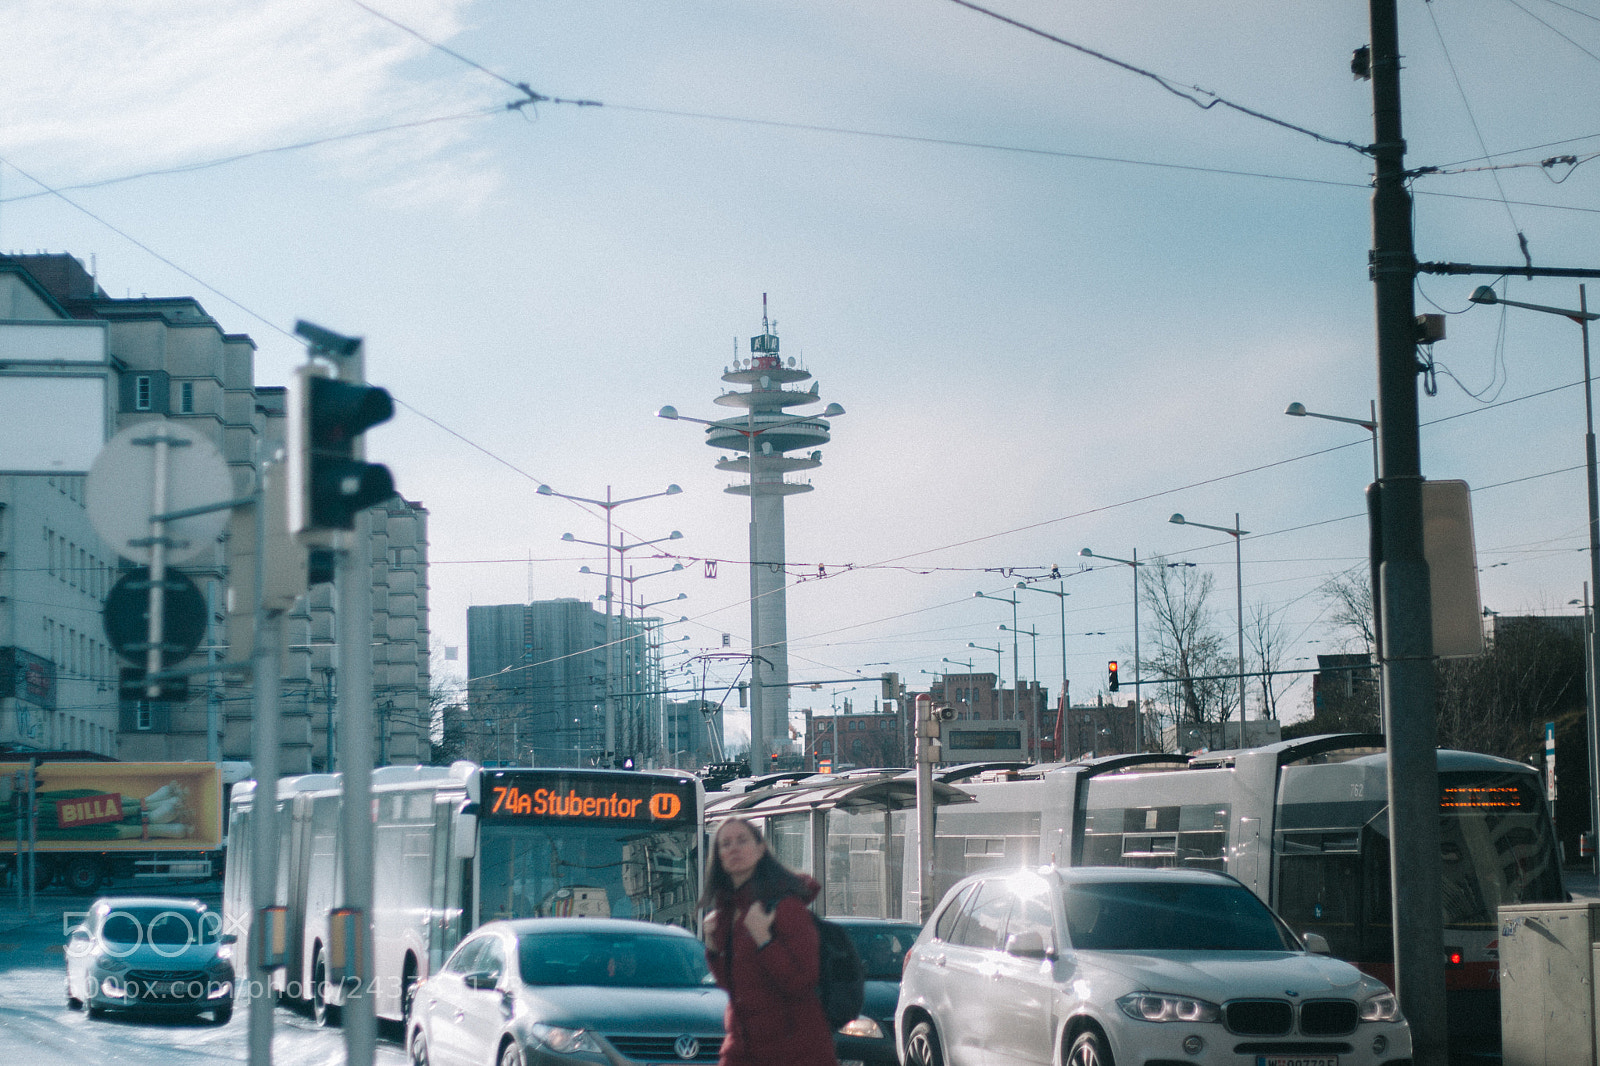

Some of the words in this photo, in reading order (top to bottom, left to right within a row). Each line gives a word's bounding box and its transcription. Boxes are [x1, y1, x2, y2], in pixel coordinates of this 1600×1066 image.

[705, 563, 716, 577] W
[723, 635, 729, 645] E
[1350, 783, 1364, 798] 762
[492, 787, 532, 814] 74A
[534, 788, 643, 818] Stubentor
[652, 794, 678, 818] U
[62, 799, 119, 823] BILLA
